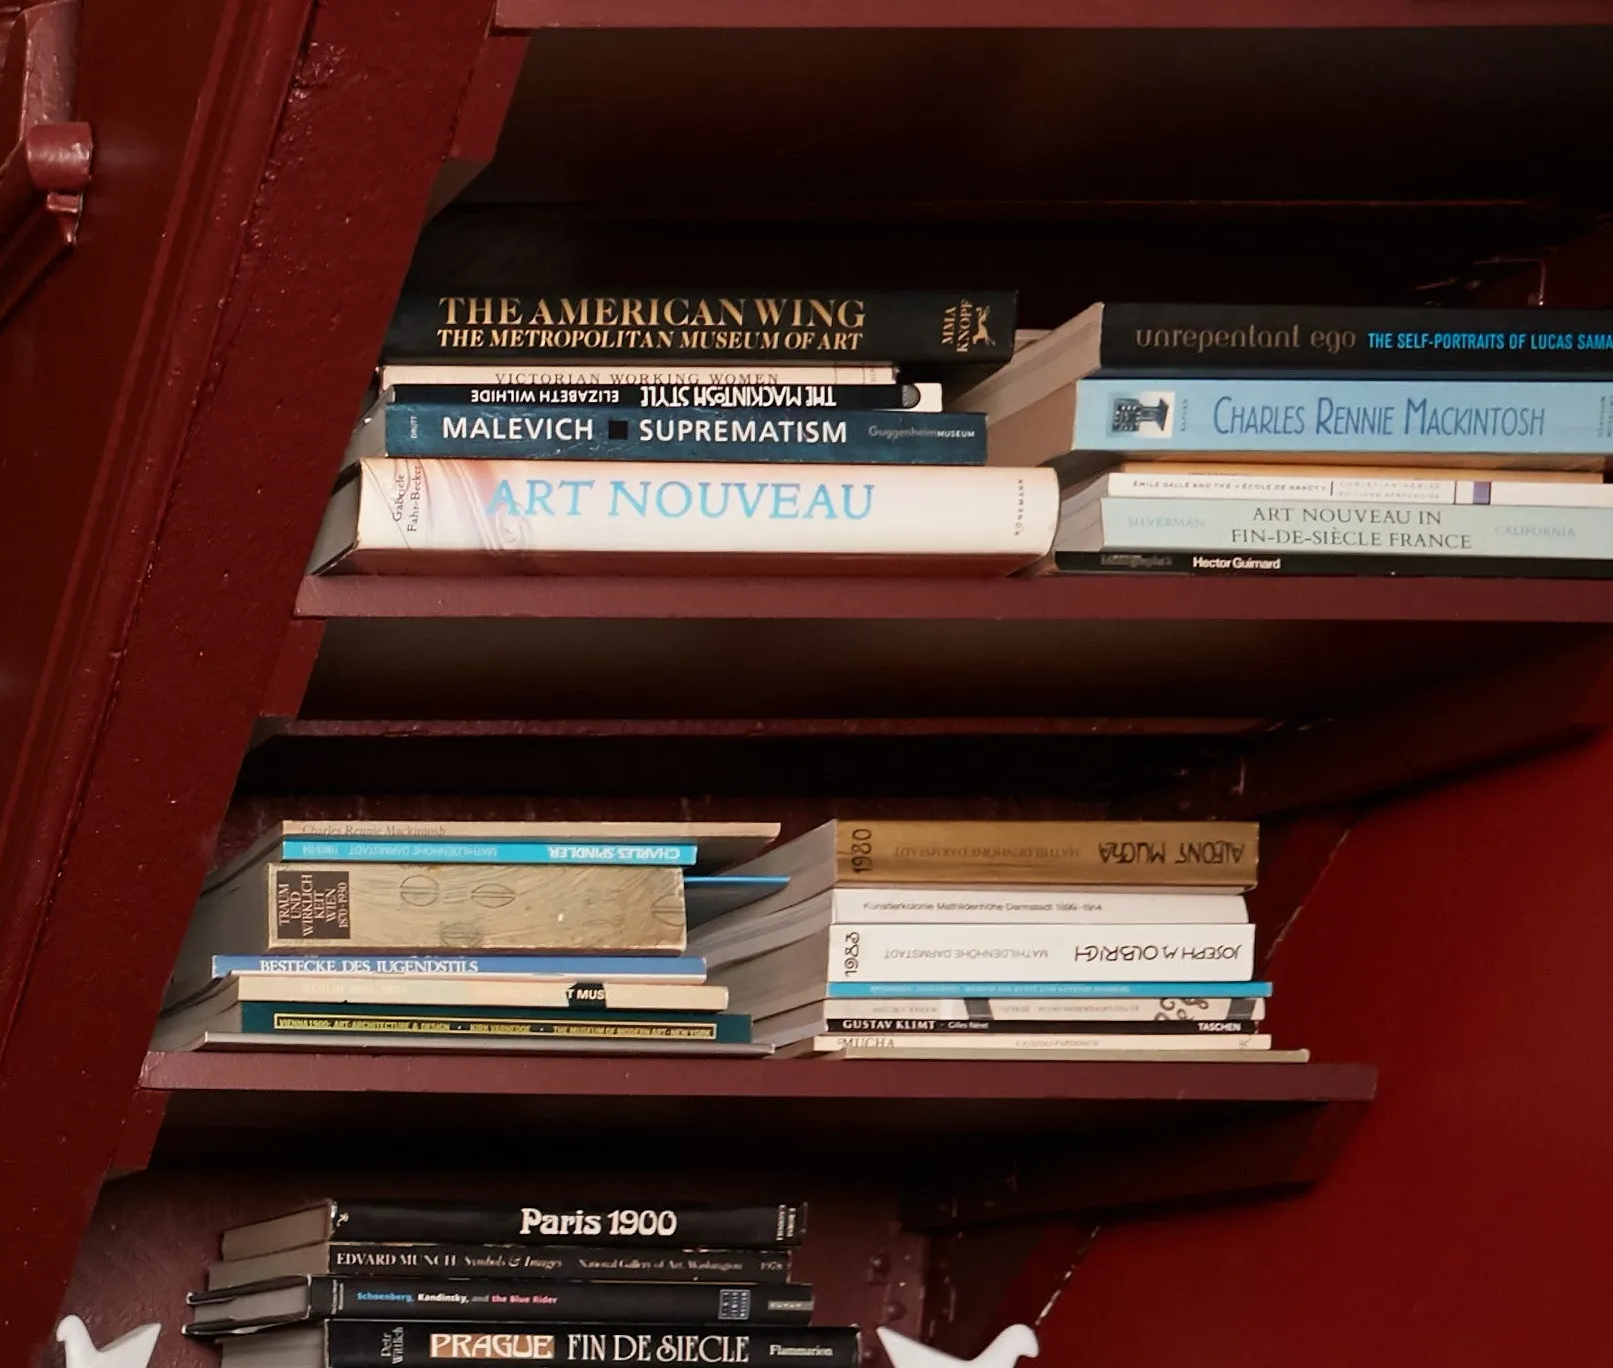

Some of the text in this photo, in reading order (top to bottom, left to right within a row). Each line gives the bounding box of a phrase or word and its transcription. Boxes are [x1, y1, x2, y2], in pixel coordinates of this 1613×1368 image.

[438, 297, 867, 328] THE AMERICAN WING
[941, 306, 957, 345] MMA
[956, 299, 974, 353] KNOPF
[436, 328, 865, 351] THE METROPOLITAN MUSEUM OF ART
[1135, 324, 1301, 354] unrepentant
[1309, 330, 1357, 355] ego
[1368, 332, 1393, 349] THE
[1396, 332, 1505, 350] SELF-PORTRAITS
[1508, 333, 1527, 350] OF
[1530, 333, 1573, 350] LUCAS
[495, 372, 779, 385] VICTORIAN WORKING WOMEN
[470, 388, 620, 403] ELIZABETH WILHIDE
[640, 384, 690, 408] STYLE
[805, 385, 837, 408] THE
[1213, 396, 1546, 437] CHARLES RENNIE MACKINTOSH
[442, 416, 848, 443] MALEVICH SUPREMATISM
[406, 465, 423, 533] Fahr-Becker
[484, 479, 876, 521] ART NOUVEAU
[1126, 515, 1206, 529] SILVERMAN
[1252, 506, 1442, 526] ART NOUVEAU IN
[1230, 526, 1473, 550] FIN-DE-SIÈCLE FRANCE
[1494, 525, 1576, 538] CALIFORNIA
[1192, 555, 1282, 570] Hector Guimard
[546, 844, 681, 861] CHARLES SPINDLER
[851, 828, 873, 874] 1980
[278, 883, 291, 927] TRAUM
[290, 890, 302, 920] UND
[301, 874, 314, 937] WIRKLICH
[314, 889, 325, 920] KEIT
[325, 887, 338, 923] WIEN
[844, 930, 861, 978] 1983
[883, 948, 952, 960] DARMSTADT
[1074, 944, 1160, 962] OLBRICH
[1180, 944, 1243, 962] JOSEPH
[259, 959, 336, 974] BESTECKE
[341, 960, 371, 974] DES
[842, 1019, 893, 1031] GUSTAV
[895, 1020, 936, 1031] KLIMT
[1198, 1022, 1242, 1032] TASCHEN
[843, 1037, 896, 1049] MUCHA
[519, 1207, 677, 1237] Paris 1900
[336, 1252, 397, 1267] EDVARD
[399, 1253, 457, 1267] MUNCH
[417, 1292, 470, 1305] Kandinsky,
[471, 1294, 490, 1304] and
[491, 1293, 508, 1304] the
[509, 1293, 531, 1304] Blue
[532, 1294, 559, 1305] Rider
[430, 1333, 750, 1364] PRAGUE FIN DE SIECLE
[768, 1343, 834, 1357] Flammarion
